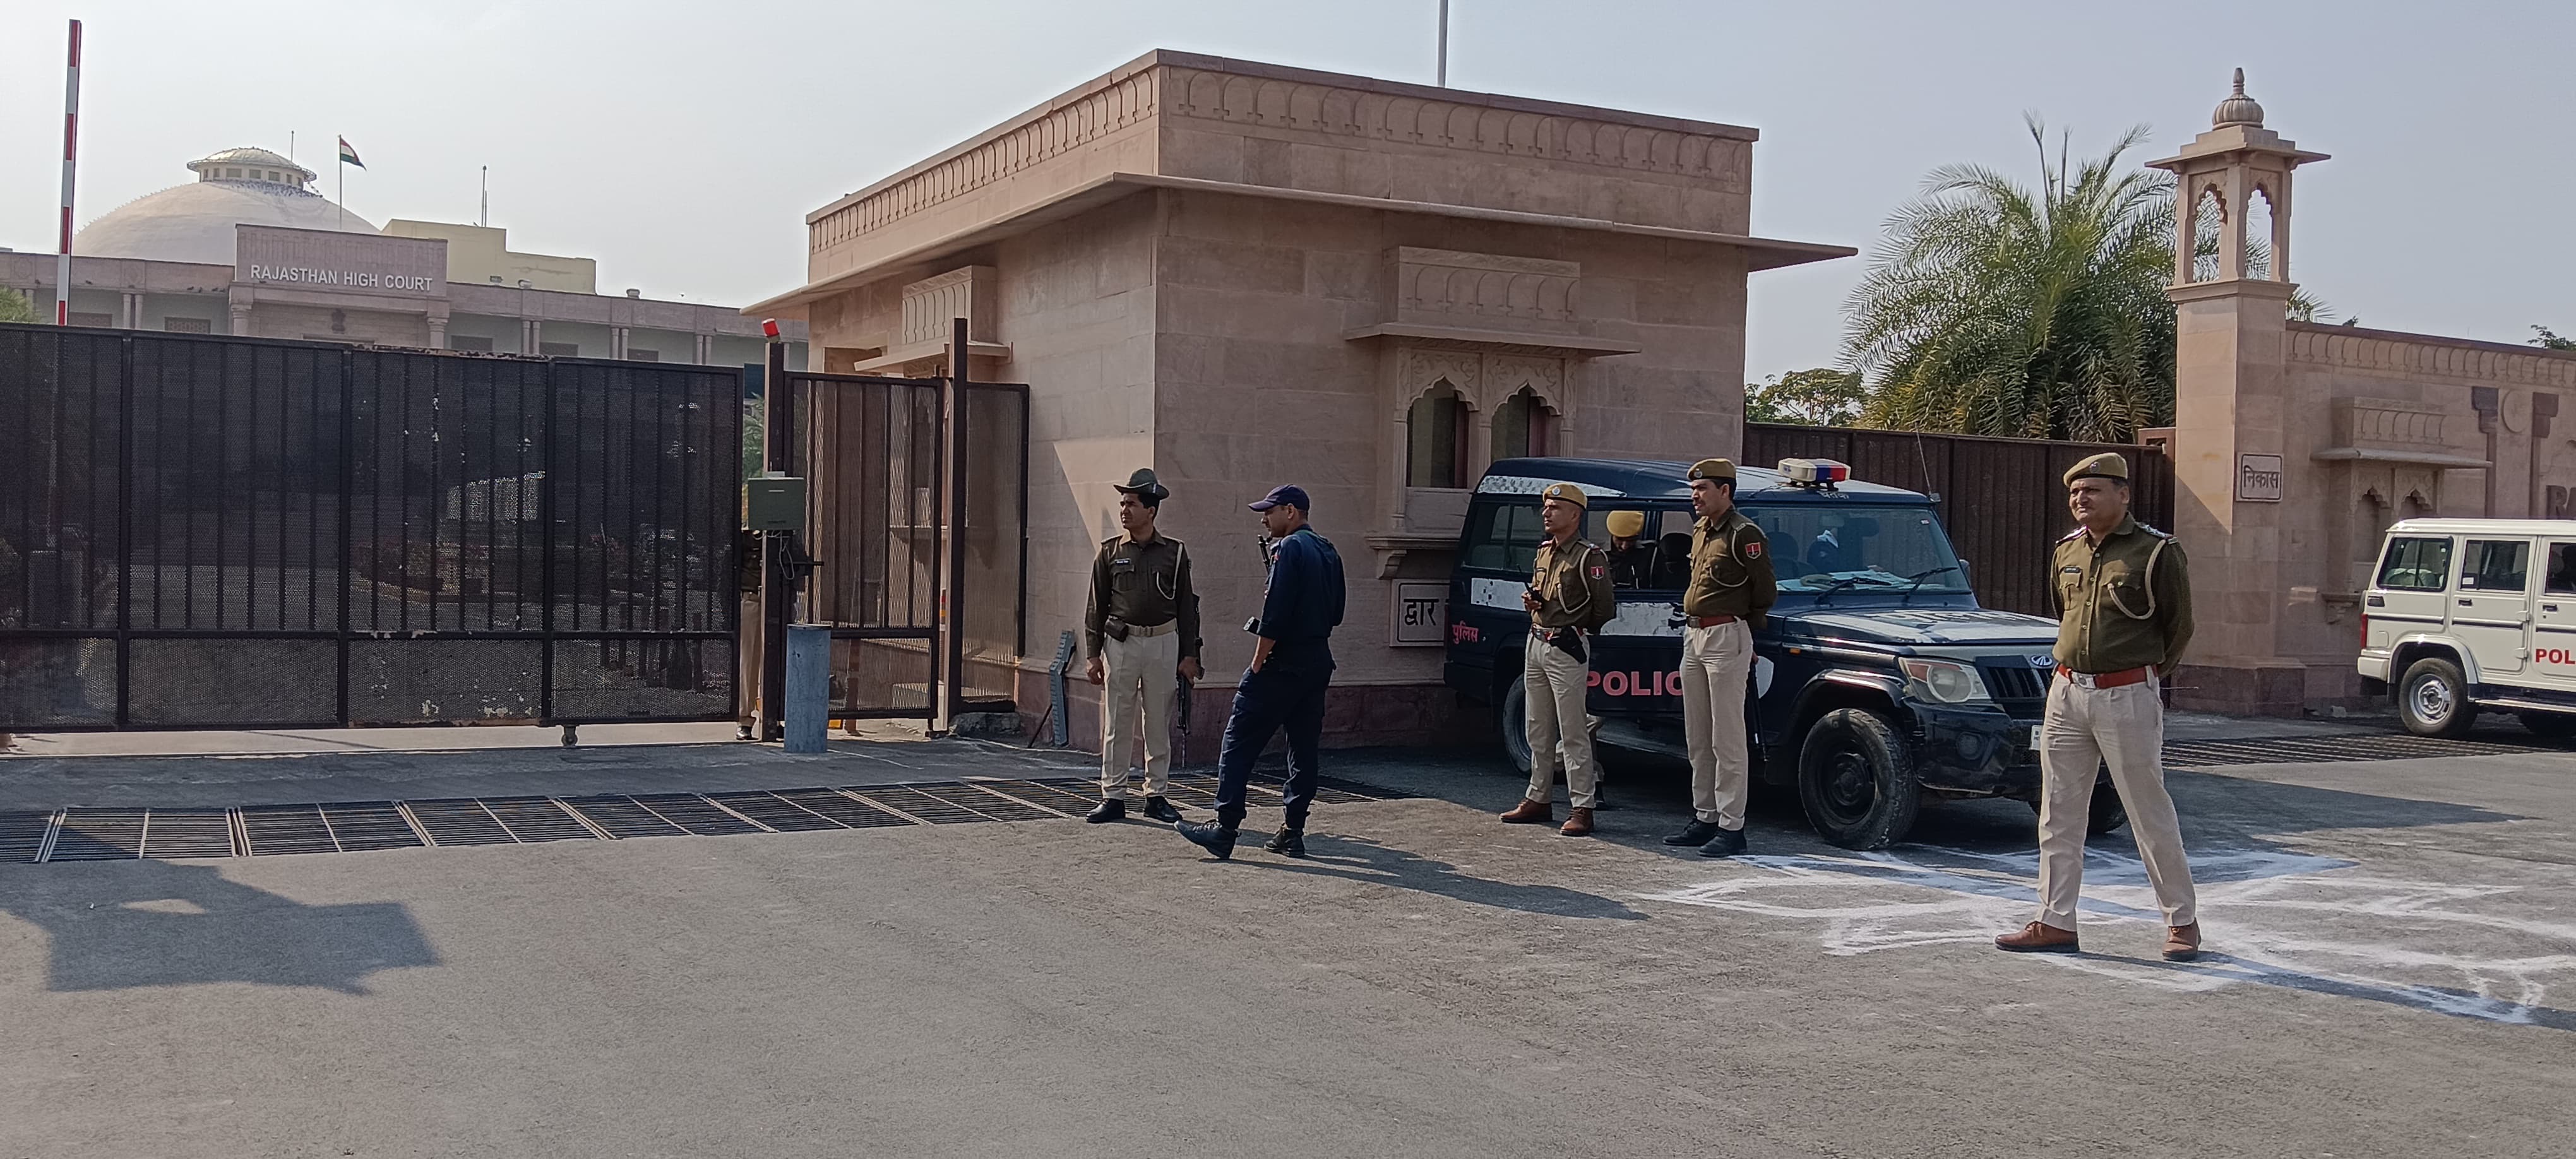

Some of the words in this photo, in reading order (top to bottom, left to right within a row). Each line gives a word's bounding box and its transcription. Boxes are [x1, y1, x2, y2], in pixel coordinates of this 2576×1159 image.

[251, 264, 337, 284] RAJASTHAN
[343, 271, 378, 288] HIGH
[385, 275, 432, 291] COURT
[2243, 465, 2280, 489] निकास
[1403, 598, 1439, 626] द्वार
[1452, 621, 1479, 645] पुलिस
[2536, 648, 2576, 665] POL
